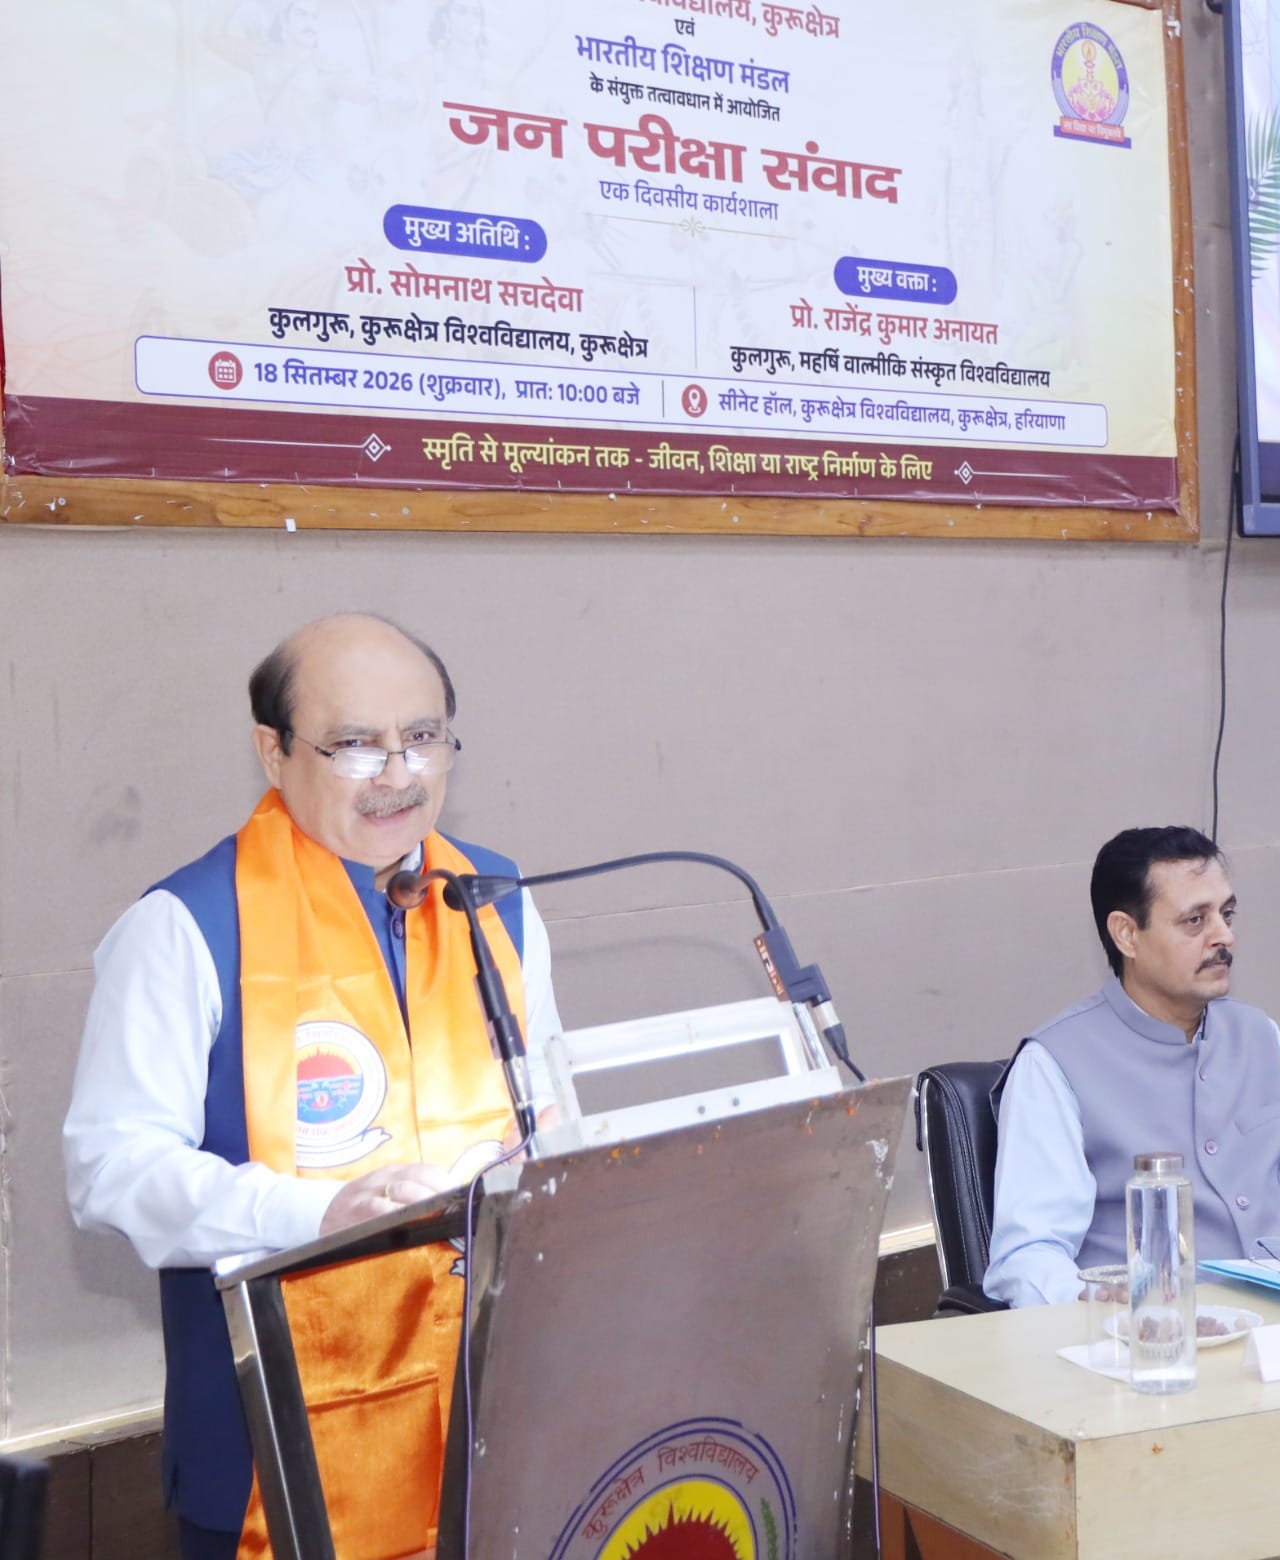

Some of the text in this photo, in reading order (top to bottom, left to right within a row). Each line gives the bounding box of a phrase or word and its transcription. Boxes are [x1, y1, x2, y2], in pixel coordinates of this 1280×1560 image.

[674, 18, 696, 37] एवं
[762, 2, 841, 38] कुरूक्षेत्र
[575, 35, 790, 93] भारतीय शिक्षण मंडल
[590, 72, 604, 93] के
[607, 77, 644, 104] संयुक्त
[714, 92, 723, 112] में
[727, 97, 780, 121] आयोजित
[443, 101, 902, 204] जन परीक्षा संवाद
[599, 181, 778, 220] एक दिवसीय कार्यशाला
[404, 216, 520, 249] मुख्य अतिथि
[344, 258, 583, 312] प्रो. सोमनाथ सचदेवा
[857, 265, 930, 293] मुख्य वक्ता
[360, 313, 439, 346] कुरूक्षेत्र
[443, 316, 574, 355] विश्वविद्यालय,
[579, 331, 648, 362] कुरूक्षेत्र
[790, 298, 998, 345] प्रो. राजेंद्र कुमार अनायत
[254, 363, 277, 384] 18
[283, 358, 358, 389] सितम्बर
[363, 370, 413, 392] 2026
[419, 373, 506, 402] (शुक्रवार),
[557, 384, 607, 404] 10:00
[612, 381, 641, 406] बजे
[799, 348, 840, 374] महर्षि
[843, 352, 907, 377] वाल्मीकि
[910, 356, 957, 387] संस्कृत
[960, 359, 1050, 387] विश्वविद्यालय
[718, 389, 759, 413] सीनेट
[762, 391, 797, 417] हॉल,
[800, 396, 856, 423] कुरूक्षेत्र
[860, 398, 955, 427] विश्वविद्यालय,
[1015, 409, 1065, 431] हरियाणा
[422, 433, 475, 470] स्मृति
[478, 434, 498, 462] से
[502, 438, 591, 473] मूल्यांकन
[594, 446, 630, 468] तक
[647, 441, 705, 475] जीवन,
[707, 446, 757, 475] शिक्षा
[760, 453, 782, 475] या
[784, 454, 820, 481] राष्ट्र
[821, 450, 877, 478] निर्माण
[879, 453, 897, 478] के
[900, 454, 933, 480] लिए
[658, 1435, 760, 1485] विश्वविद्यालय
